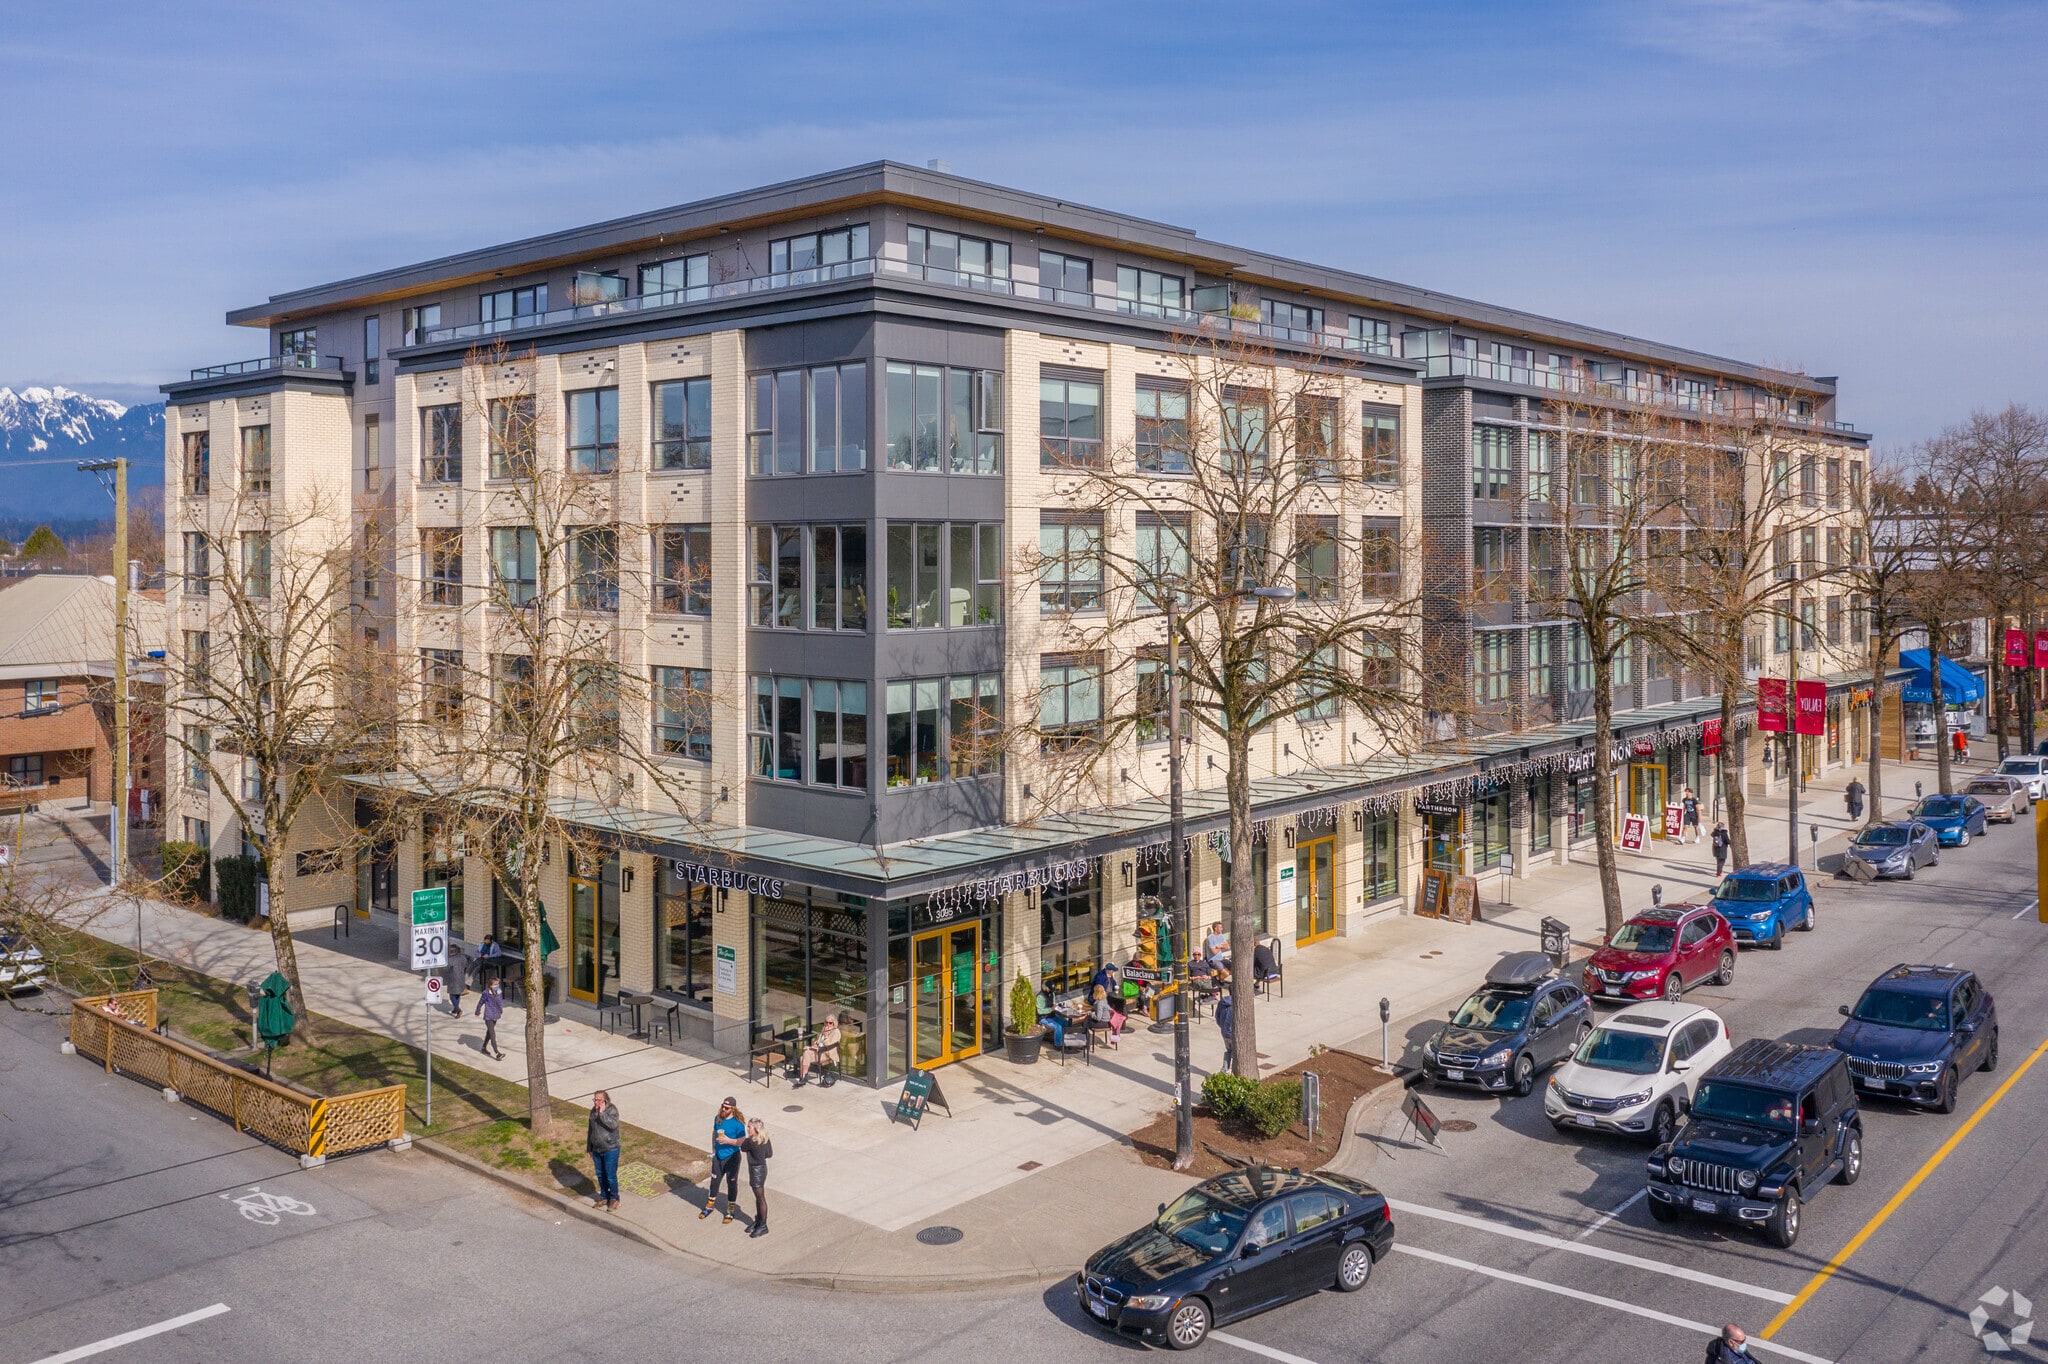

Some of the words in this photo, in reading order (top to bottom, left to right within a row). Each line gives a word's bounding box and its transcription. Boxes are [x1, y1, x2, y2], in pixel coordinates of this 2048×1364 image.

[1568, 743, 1631, 774] PARTNON
[1417, 804, 1458, 813] PARTHENON
[1625, 833, 1641, 842] OPEN
[676, 861, 784, 899] STARBUCKS
[976, 858, 1088, 901] STARBUCKS
[936, 907, 954, 919] 3095
[415, 926, 445, 936] MAXIMUM
[415, 936, 444, 957] 30
[421, 958, 438, 966] km/h
[1126, 969, 1155, 980] Balaclava
